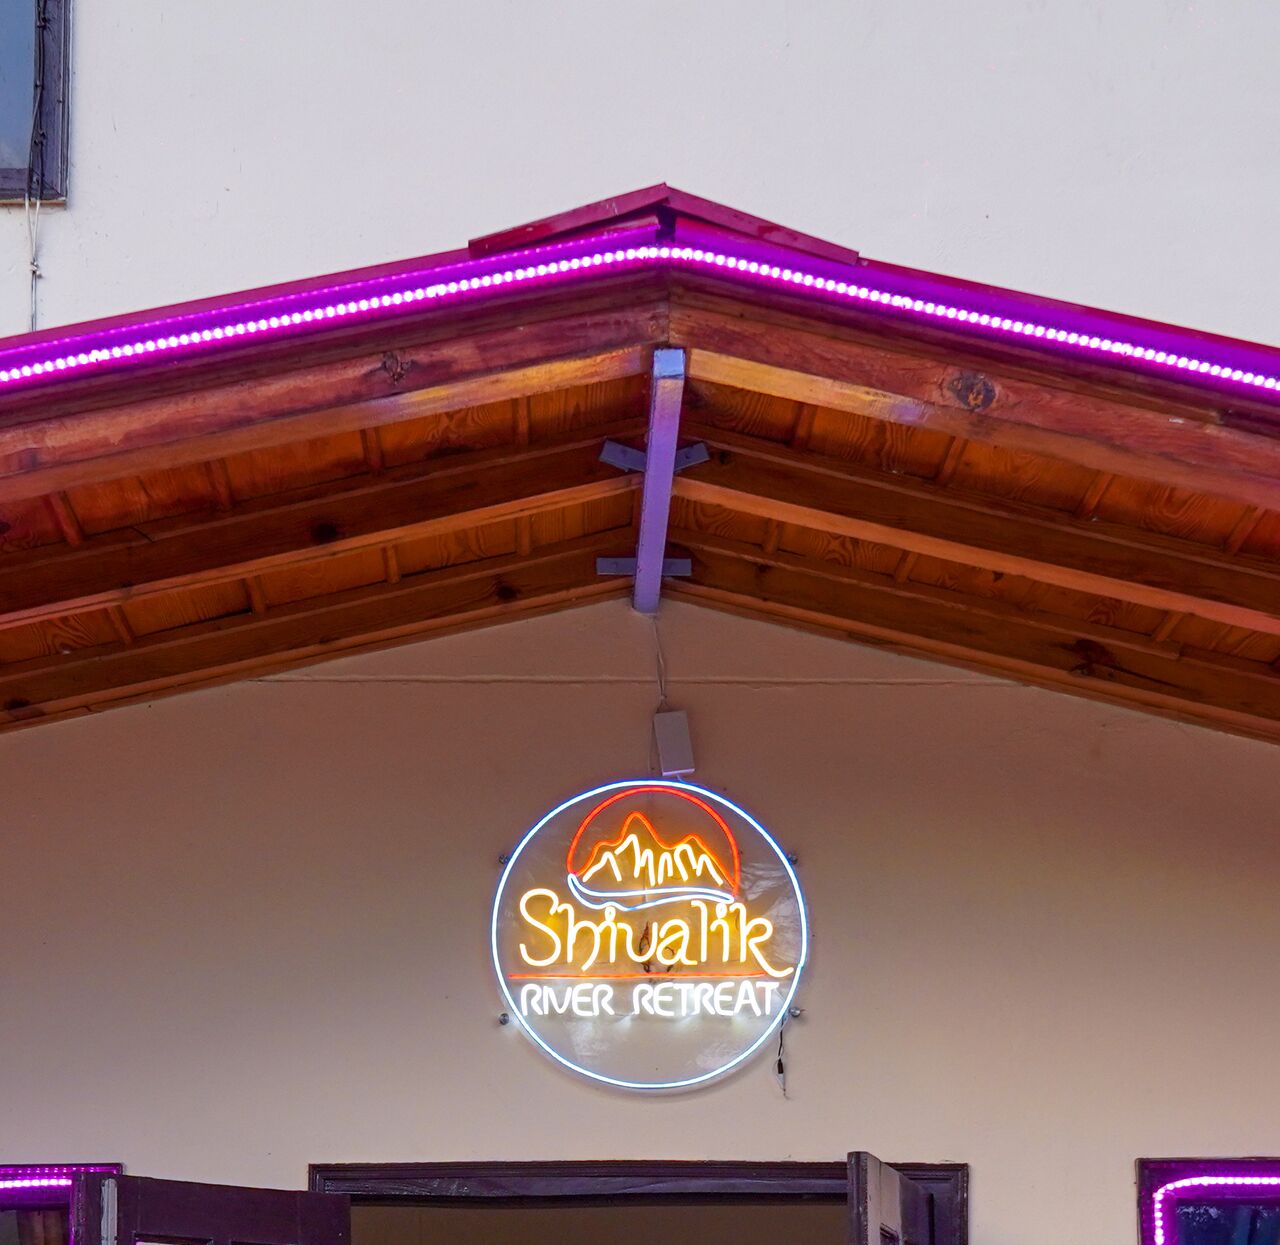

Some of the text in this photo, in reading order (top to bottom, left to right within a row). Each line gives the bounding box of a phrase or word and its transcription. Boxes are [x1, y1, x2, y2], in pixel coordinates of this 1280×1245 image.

[518, 887, 796, 978] Shivalik
[519, 979, 782, 1018] RIVER RETREAT
